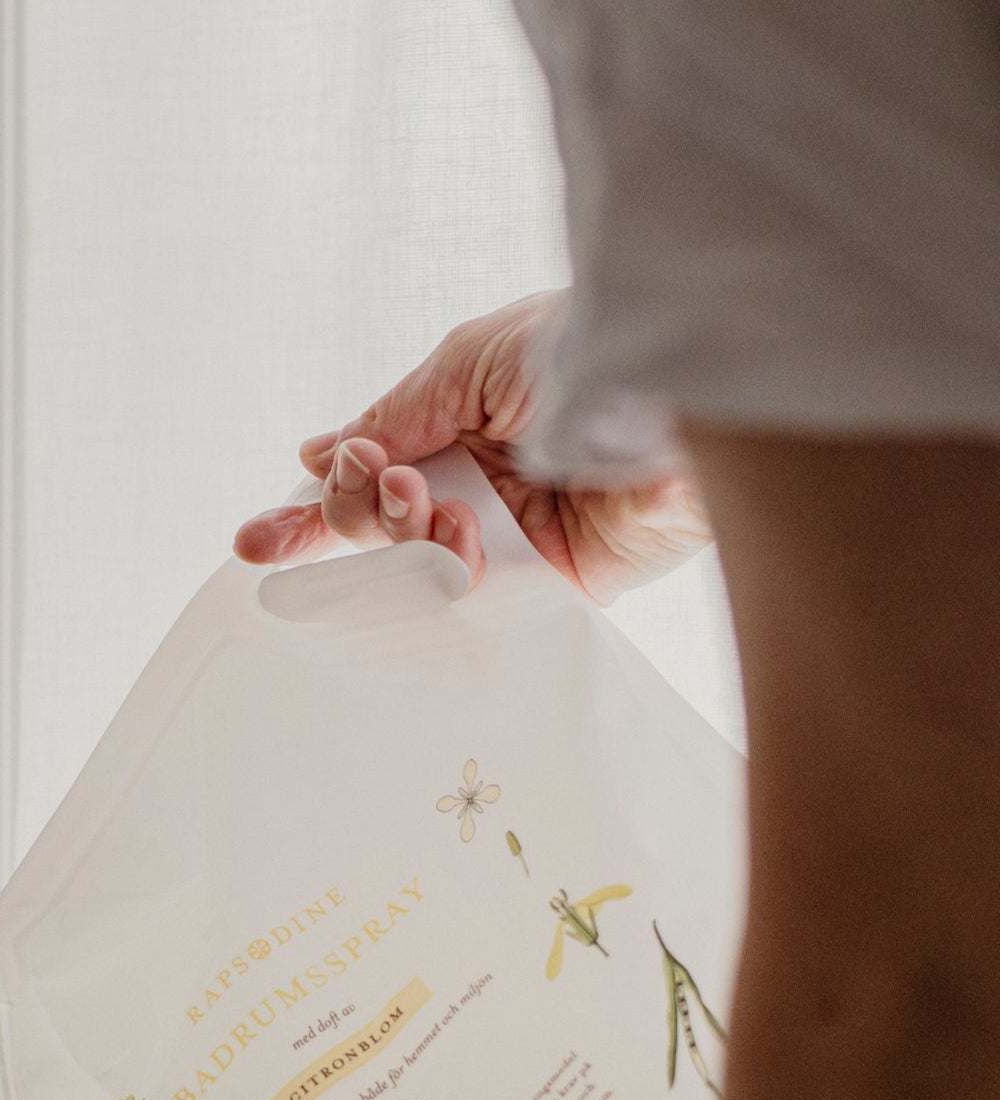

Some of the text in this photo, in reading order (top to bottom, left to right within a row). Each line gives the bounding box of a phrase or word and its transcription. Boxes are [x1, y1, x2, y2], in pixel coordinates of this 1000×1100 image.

[187, 887, 347, 1026] RAPSODINE
[292, 1003, 357, 1051] med doft av
[388, 1060, 406, 1088] för
[405, 1022, 442, 1067] hemmet
[441, 1002, 458, 1026] och
[456, 972, 493, 1009] miljön
